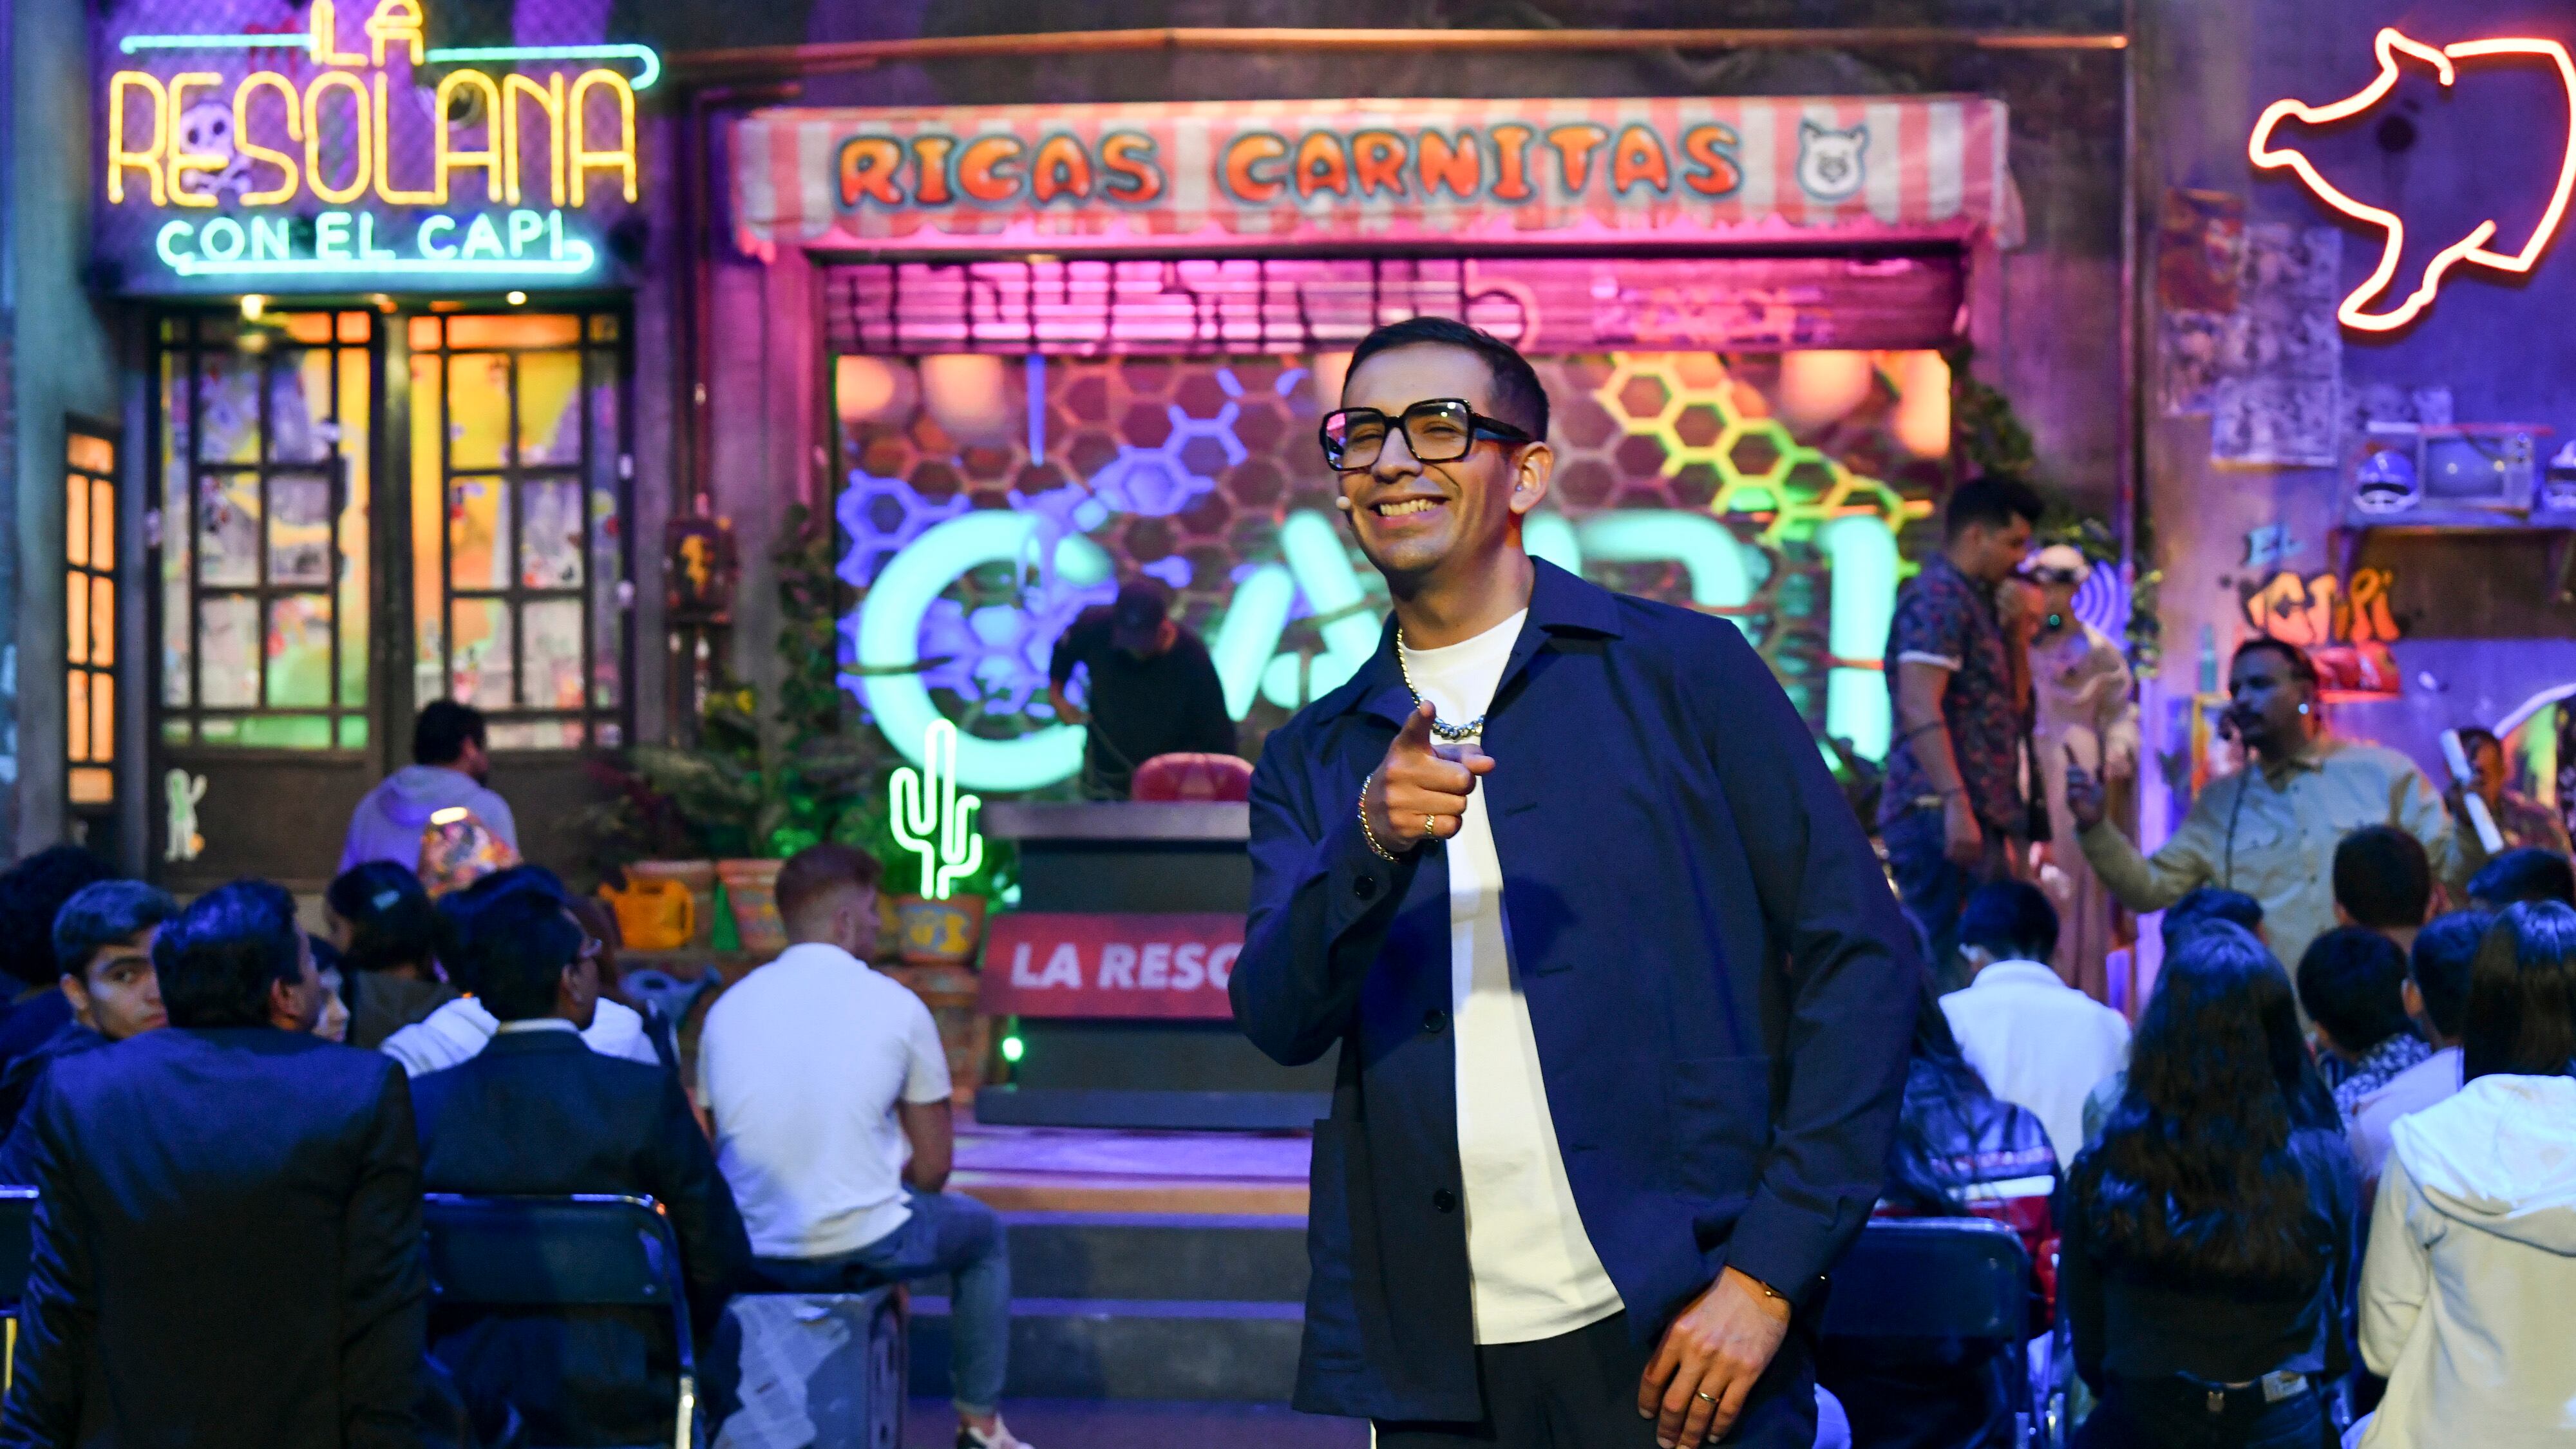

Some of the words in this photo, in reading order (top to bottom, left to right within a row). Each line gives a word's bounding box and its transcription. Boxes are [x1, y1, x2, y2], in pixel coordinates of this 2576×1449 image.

[309, 0, 425, 67] LA
[107, 68, 638, 208] RESOLANA
[835, 131, 1166, 210] RICAS
[1217, 119, 1745, 204] CARNITAS
[156, 215, 290, 265] CON
[314, 211, 395, 260] EL
[416, 209, 564, 260] CAPI
[1009, 942, 1083, 990] LA
